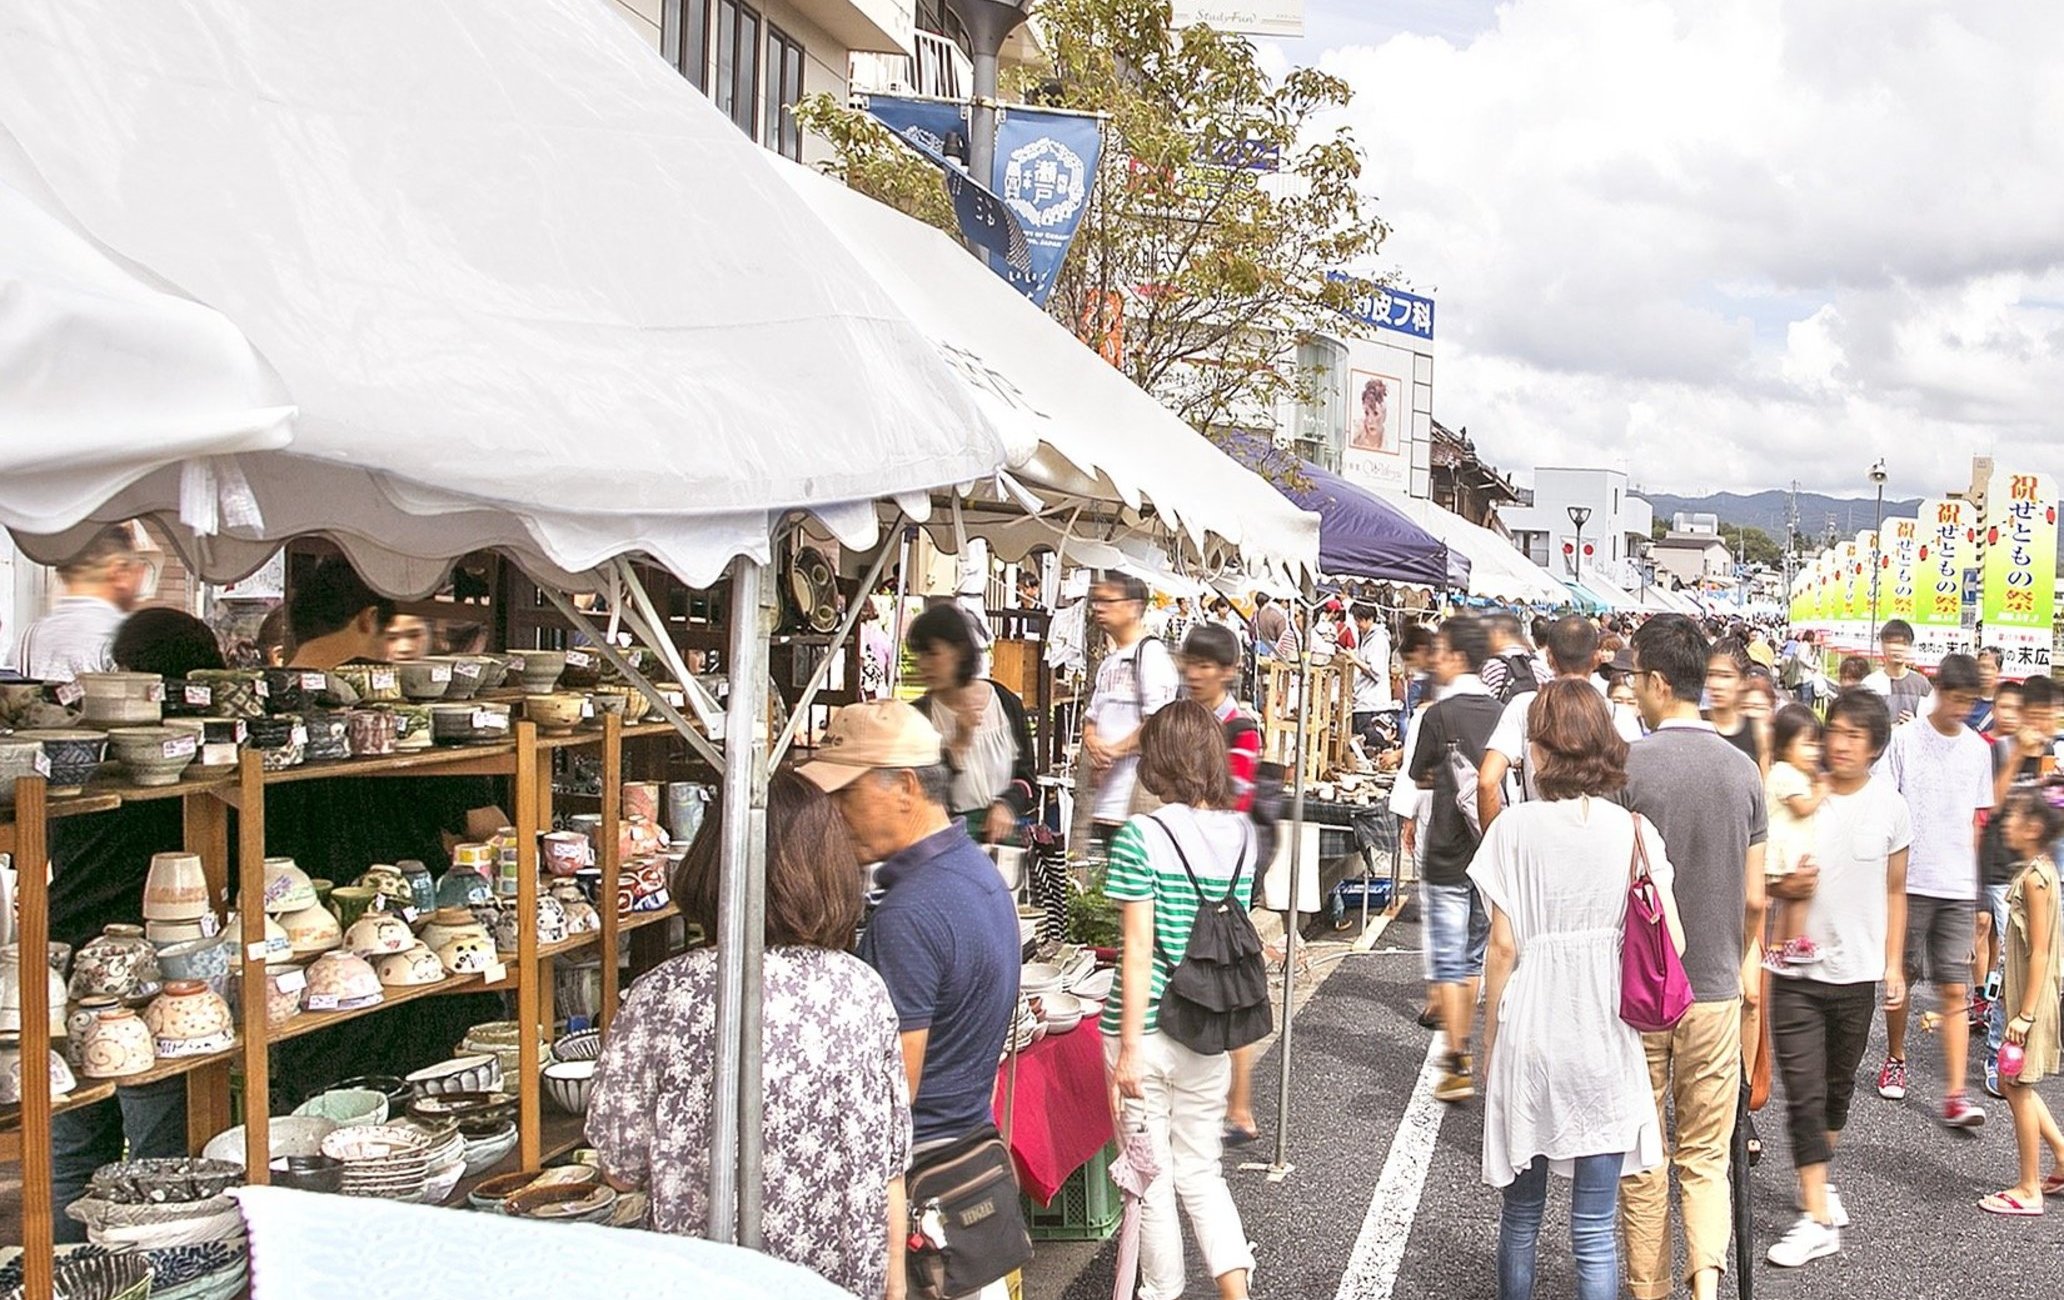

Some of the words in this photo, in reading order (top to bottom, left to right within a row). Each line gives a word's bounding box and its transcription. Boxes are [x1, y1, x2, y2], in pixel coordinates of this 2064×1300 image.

[1935, 503, 1961, 613] 祝せともの祭
[2006, 474, 2039, 611] 祝せともの祭
